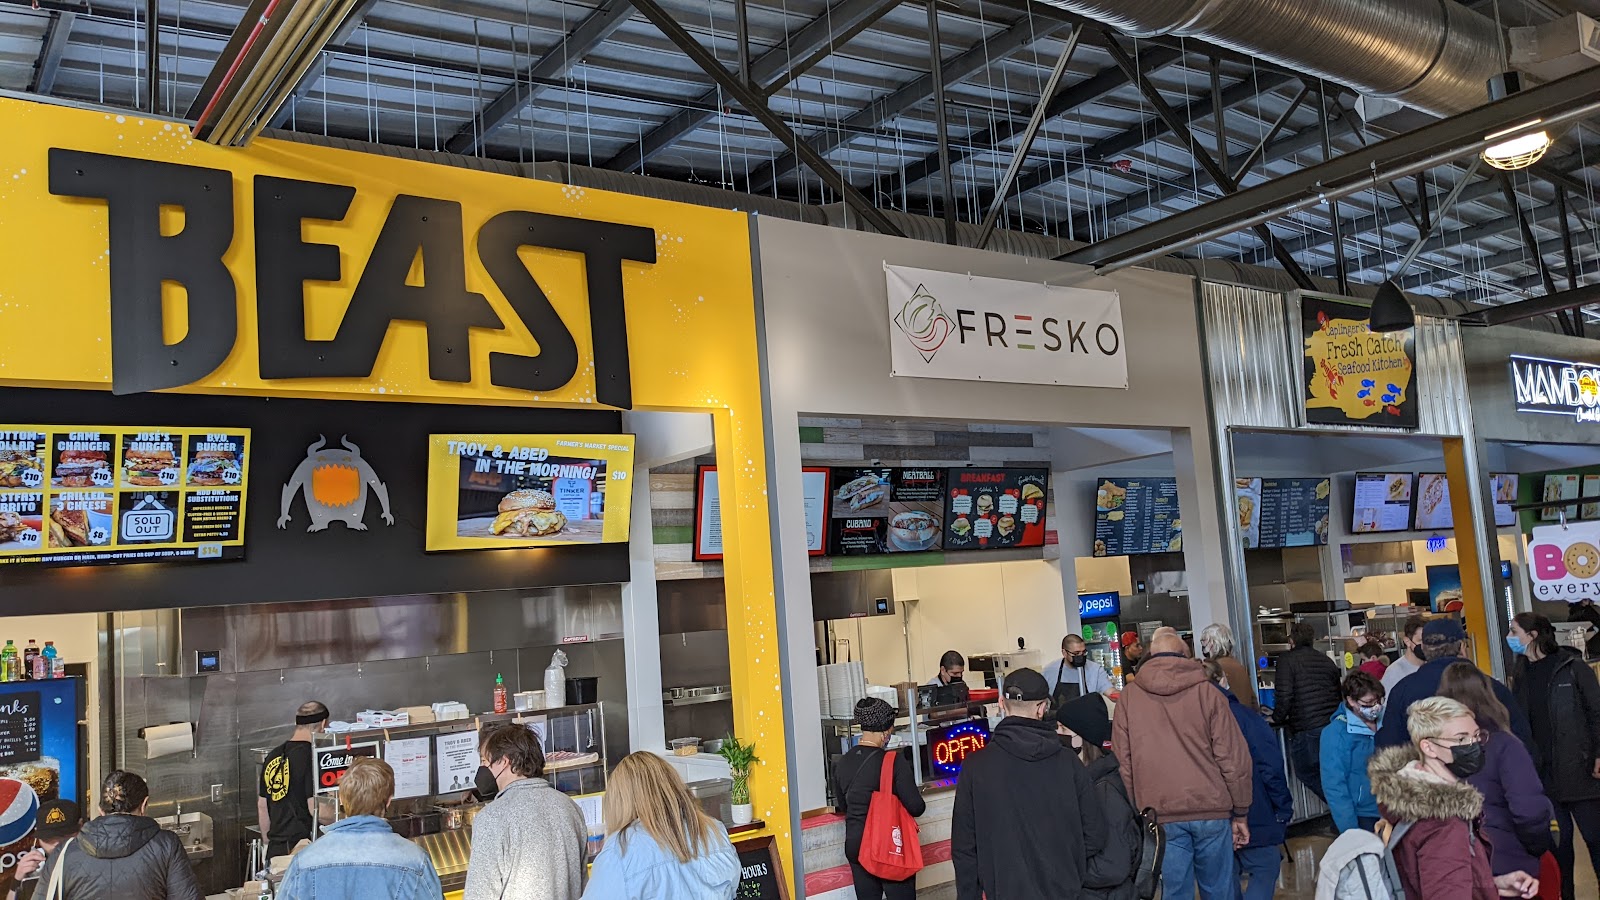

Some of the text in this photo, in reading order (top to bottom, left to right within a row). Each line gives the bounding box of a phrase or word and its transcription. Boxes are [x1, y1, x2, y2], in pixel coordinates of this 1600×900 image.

[48, 147, 656, 410] BEAST
[956, 308, 1119, 356] FRESKO
[1366, 334, 1402, 356] Catch
[1337, 357, 1402, 376] Seafood Kitchen
[69, 432, 100, 441] GAME
[57, 441, 111, 451] CHANGER
[131, 442, 174, 451] BURGER
[196, 442, 237, 451] BURGER
[447, 441, 549, 461] TROY & ABED
[556, 440, 630, 452] FARMER'S MARKET SPECIAL
[475, 458, 598, 480] IN THE MORNING!
[24, 472, 40, 481] $10
[93, 472, 109, 481] $10
[161, 471, 175, 480] $10
[224, 471, 237, 479] $10
[612, 470, 627, 480] $10
[902, 471, 934, 480] MEATBALL
[960, 473, 1006, 483] BREAKFAST
[59, 491, 105, 500] GRILLED
[57, 501, 107, 511] 3 CHEESE
[134, 516, 161, 525] SOLD
[846, 519, 871, 528] CUBANO
[93, 531, 104, 539] $8
[136, 526, 159, 534] OUT
[22, 533, 37, 542] $10
[1540, 580, 1600, 596] every
[1085, 596, 1113, 613] pepsi
[320, 753, 354, 767] Come in
[741, 862, 768, 880] HOURS
